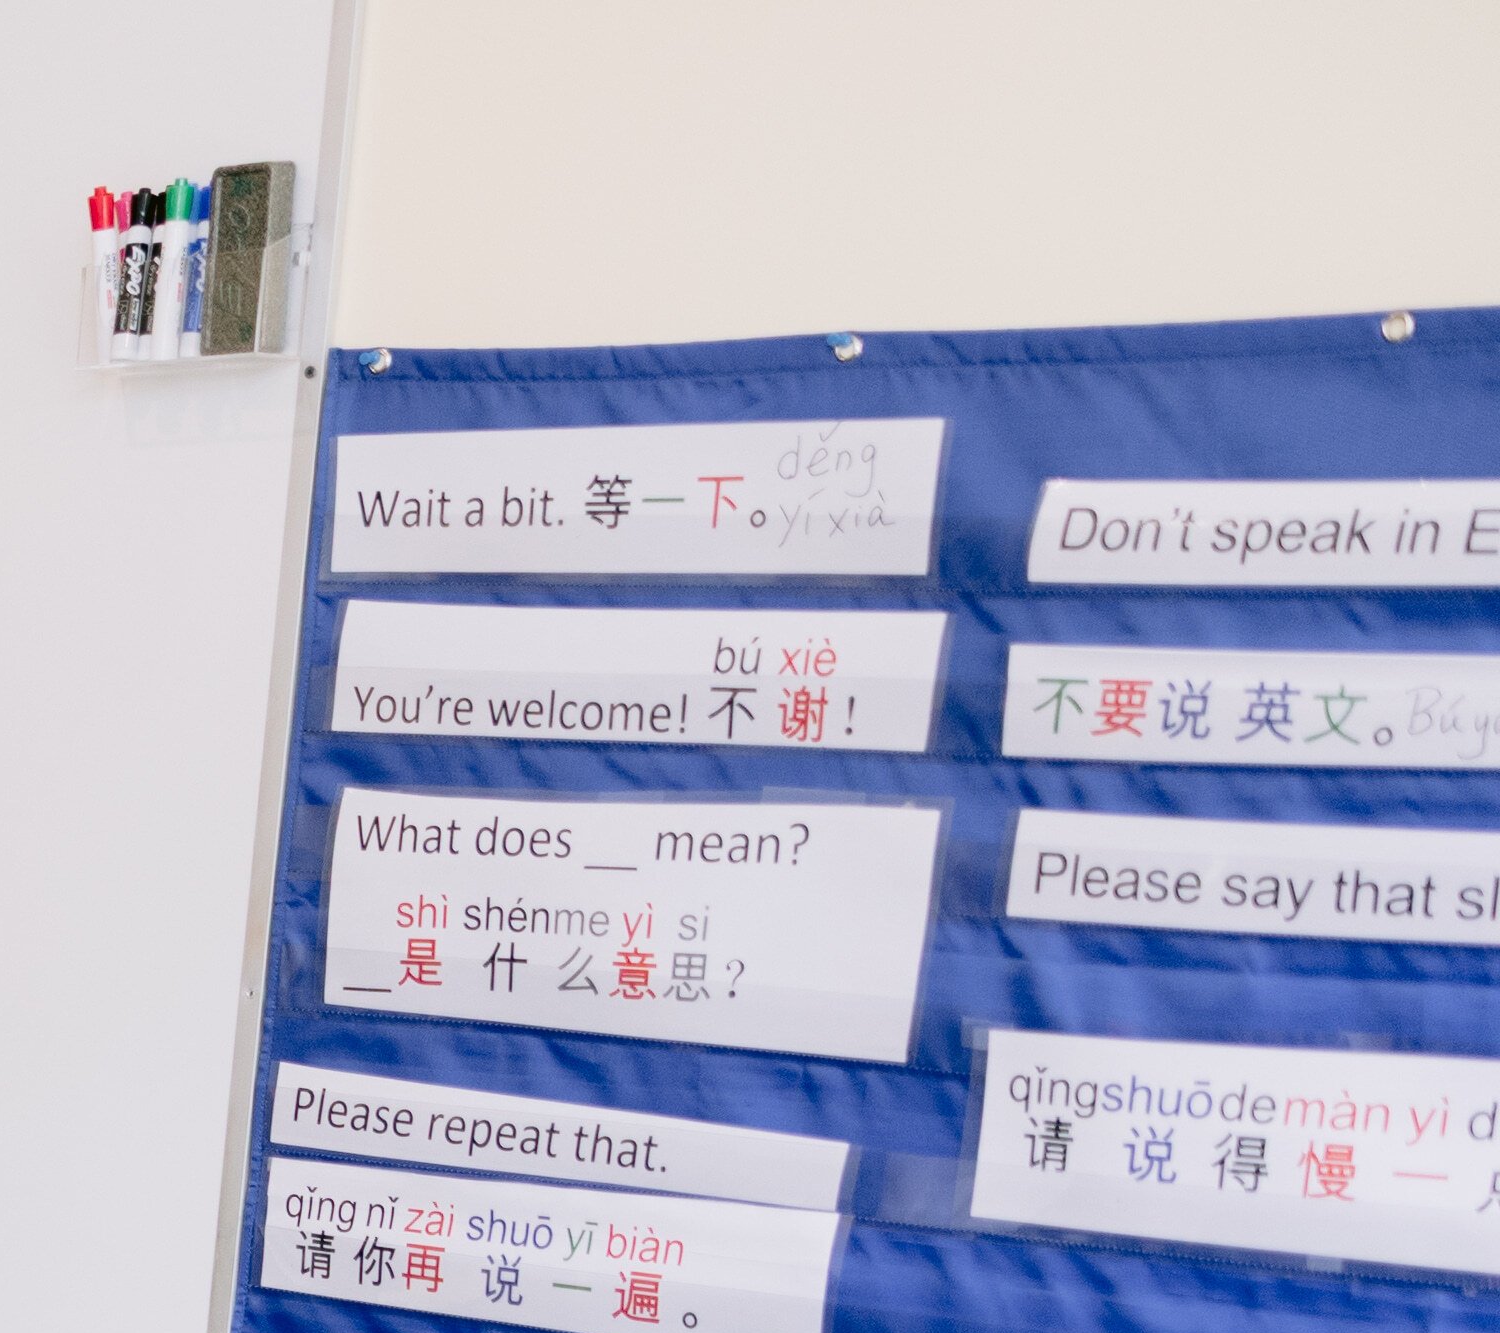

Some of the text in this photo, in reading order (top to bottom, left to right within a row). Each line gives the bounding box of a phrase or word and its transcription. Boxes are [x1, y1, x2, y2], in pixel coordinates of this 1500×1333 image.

[358, 488, 449, 528] Wait
[464, 499, 484, 528] a
[501, 486, 564, 528] bit.
[1211, 507, 1377, 564] speak
[1394, 510, 1441, 555] in
[714, 636, 836, 678] bú xiè
[489, 689, 688, 736] welcome!
[356, 814, 459, 856] What
[475, 816, 572, 860] does
[654, 822, 809, 867] mean?
[1033, 851, 1202, 903] Please
[1221, 873, 1315, 922] say
[1333, 870, 1435, 918] that
[397, 896, 449, 930] shì
[462, 897, 610, 938] shénme
[622, 901, 654, 948] yì
[293, 1088, 668, 1175] Please repeat that.
[285, 1188, 685, 1269] qǐng nǐ zài shuō yī biàn
